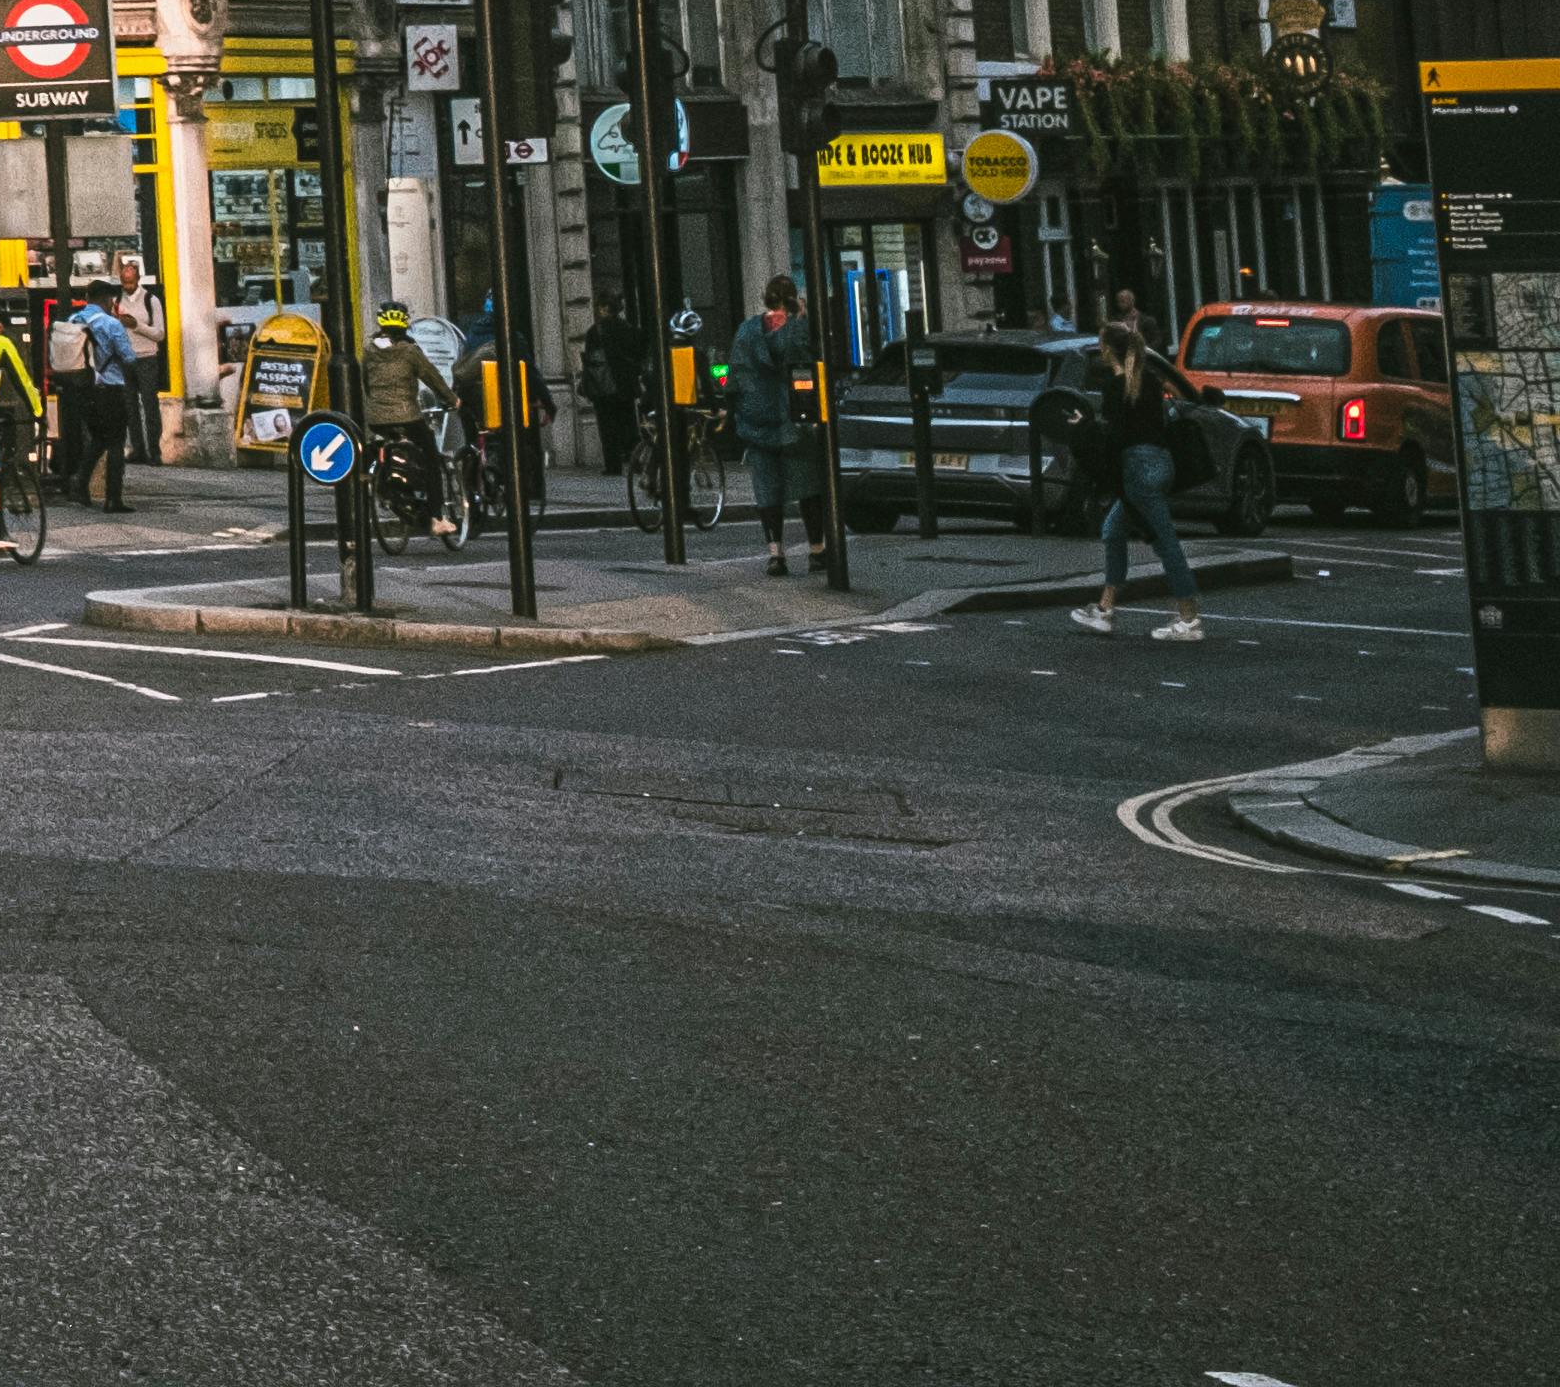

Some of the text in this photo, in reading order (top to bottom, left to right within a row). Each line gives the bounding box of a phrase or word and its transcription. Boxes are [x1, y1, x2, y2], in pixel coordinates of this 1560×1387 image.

[15, 90, 89, 108] SUBWAY
[998, 87, 1068, 110] VAPE
[1000, 114, 1069, 129] STATION
[847, 144, 856, 166] &
[861, 144, 904, 165] BOOZE
[908, 144, 933, 164] HUB
[970, 156, 1027, 166] TOBACCO
[255, 372, 307, 384] PASSPORT
